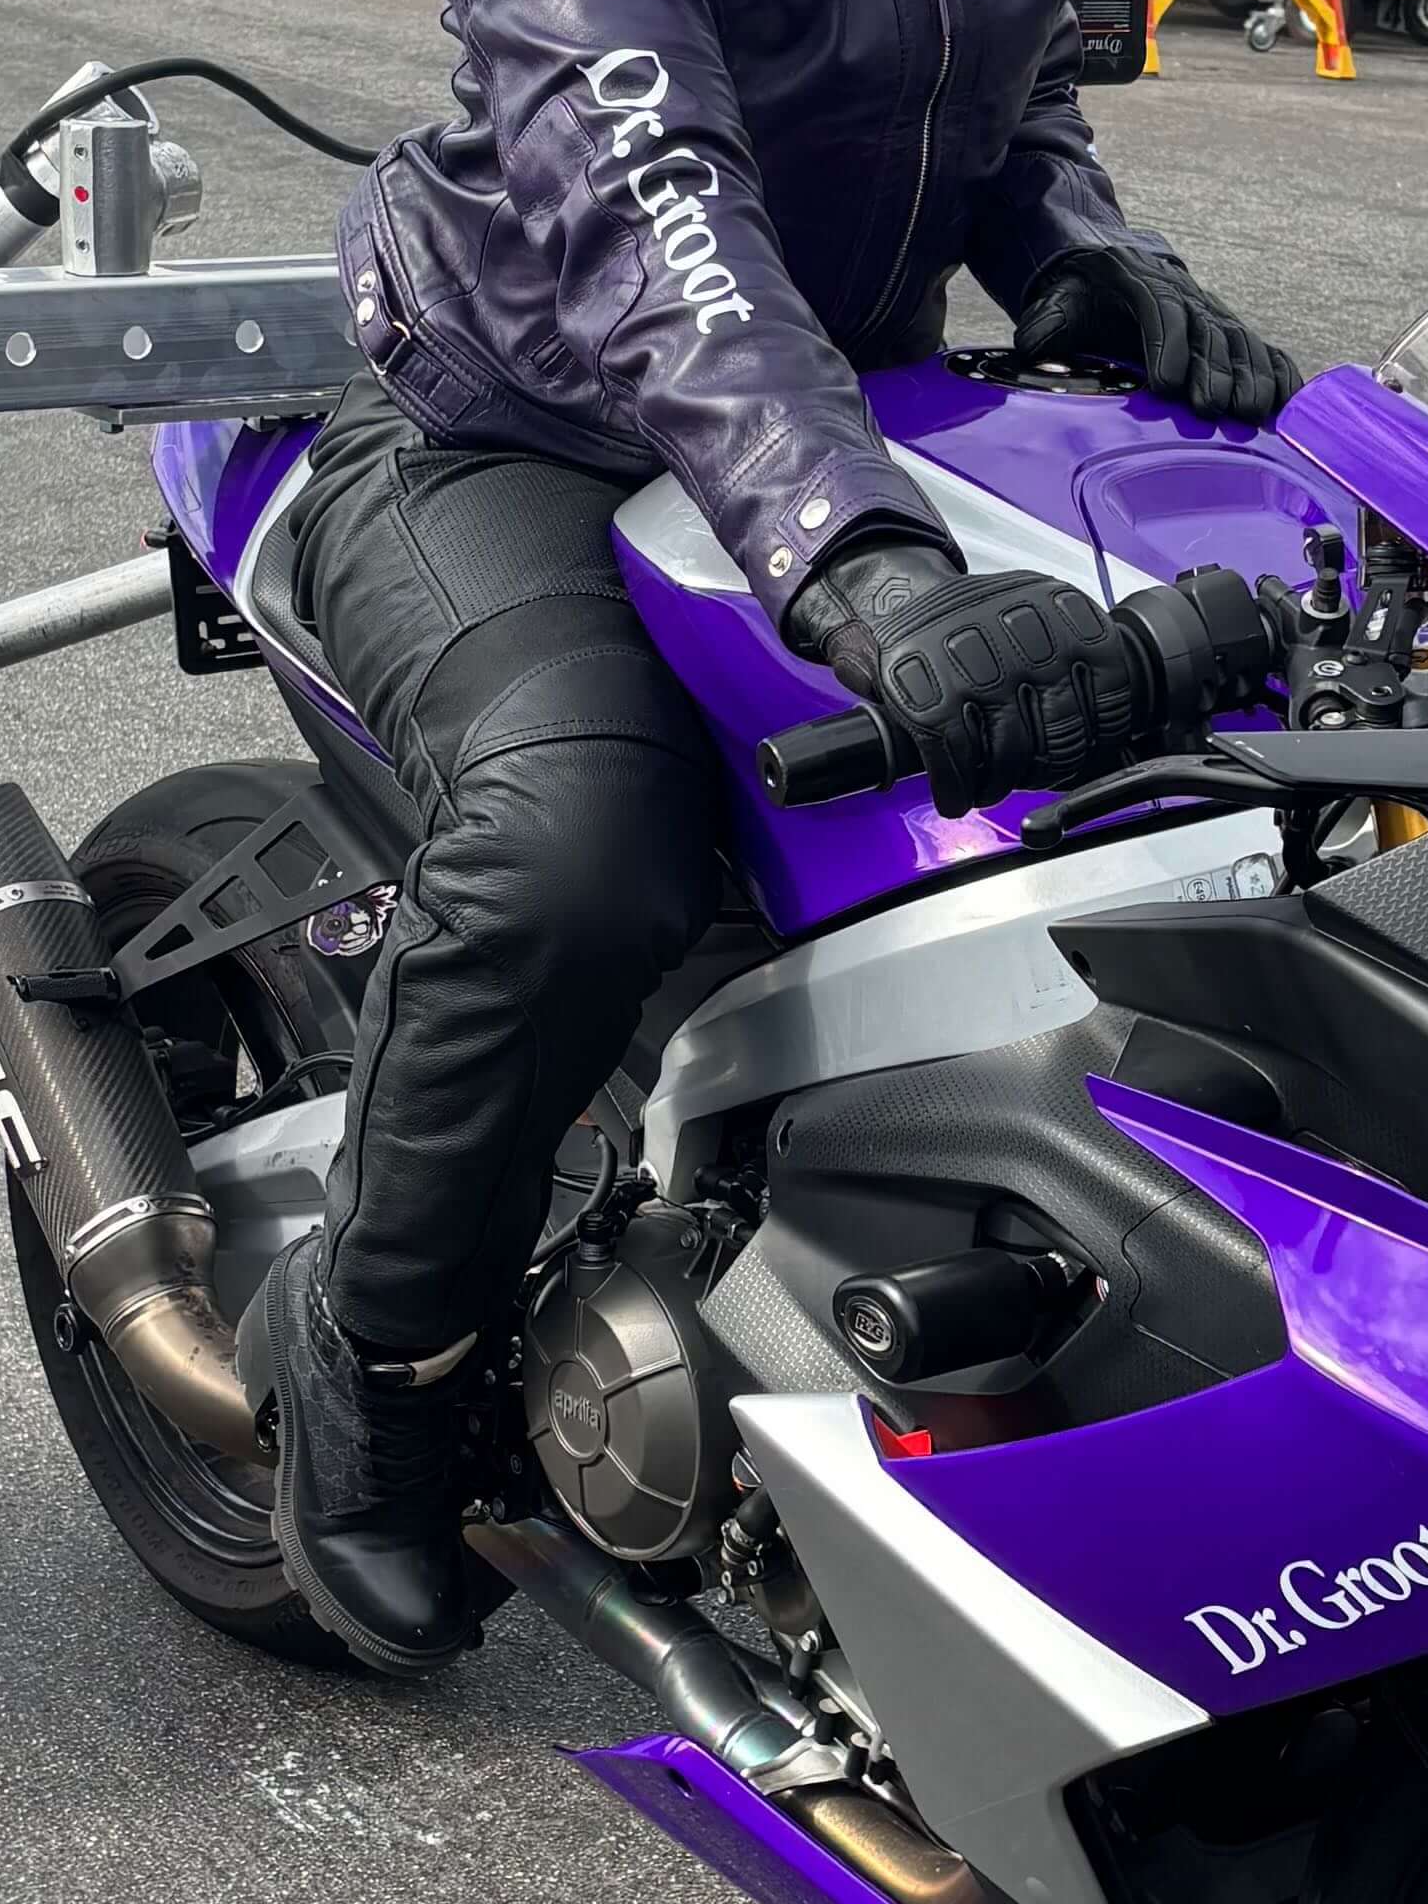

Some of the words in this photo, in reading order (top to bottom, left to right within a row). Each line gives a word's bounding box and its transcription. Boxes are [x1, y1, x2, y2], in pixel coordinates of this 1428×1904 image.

[1083, 34, 1123, 53] Dyna
[576, 48, 669, 158] Dr.
[627, 148, 754, 335] Groot
[555, 1389, 601, 1432] aprilia
[1184, 1605, 1307, 1675] Dr.
